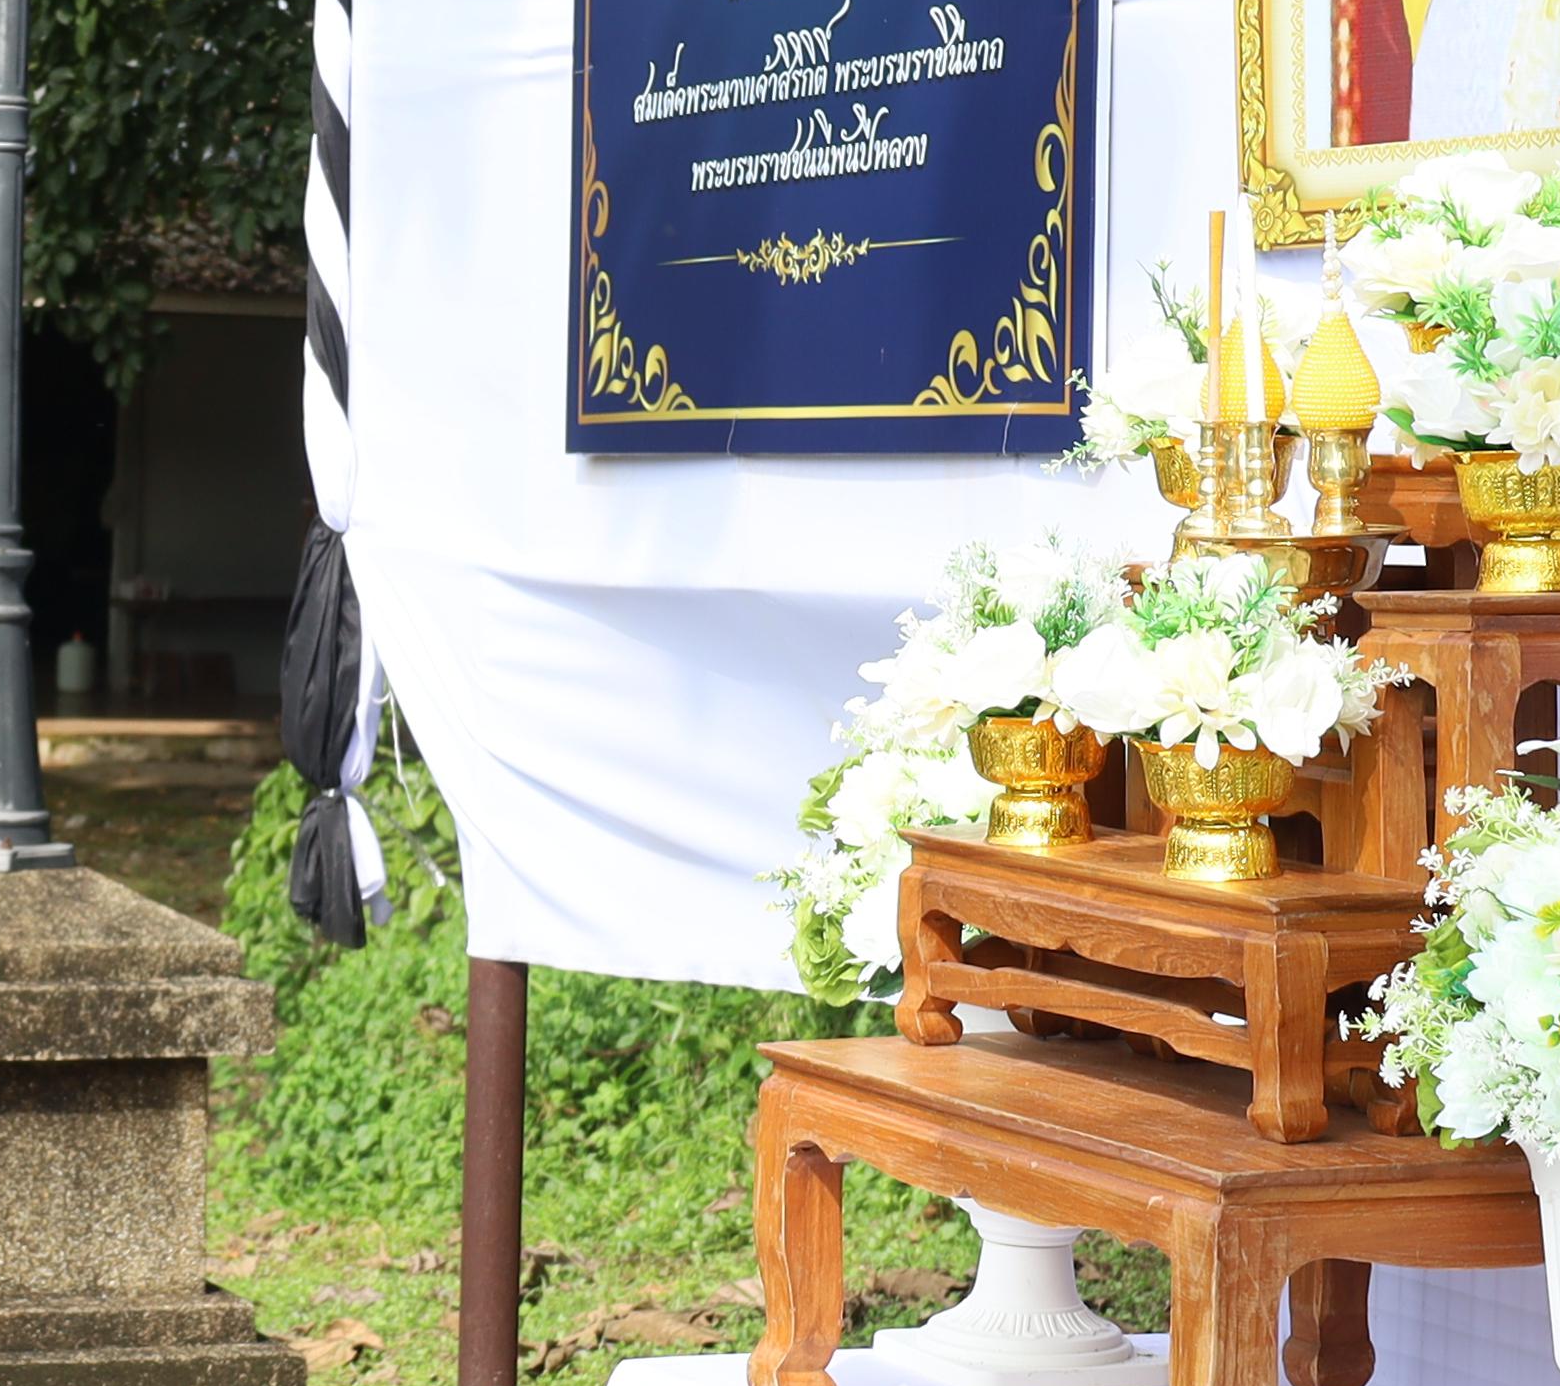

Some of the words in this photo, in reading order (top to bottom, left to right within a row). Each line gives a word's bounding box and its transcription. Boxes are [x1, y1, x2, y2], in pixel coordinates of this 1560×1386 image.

[834, 3, 1004, 93] พระบรมราชินีนาถ
[691, 102, 928, 191] พระบรมราชชนนีพันปีหลวง
